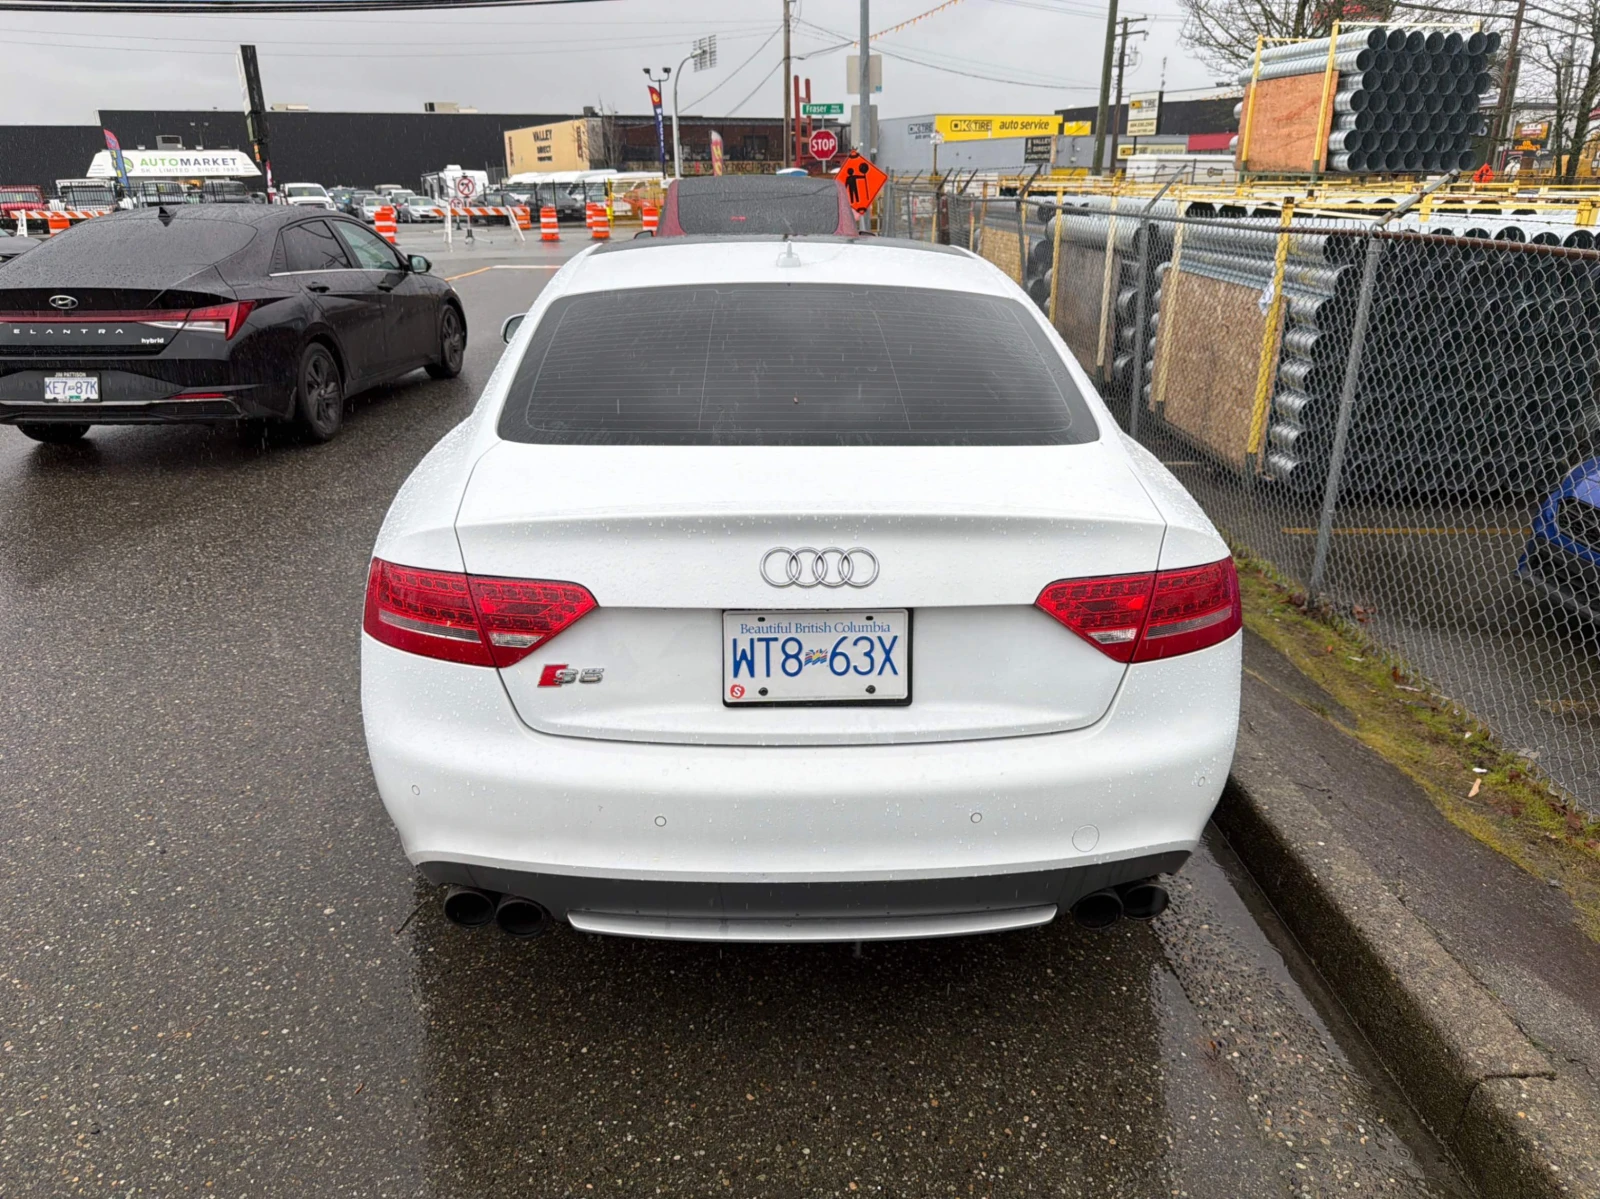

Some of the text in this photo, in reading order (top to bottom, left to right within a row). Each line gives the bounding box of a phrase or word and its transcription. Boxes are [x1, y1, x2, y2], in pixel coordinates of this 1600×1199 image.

[805, 105, 827, 113] Fraser
[951, 120, 992, 132] OK TIRE
[999, 119, 1049, 130] auto service
[533, 129, 552, 142] VALLEY
[811, 137, 835, 150] STOP
[140, 157, 237, 167] AUTOMARKET
[141, 337, 165, 345] hybrid
[740, 621, 891, 635] Beautiful British Columbia
